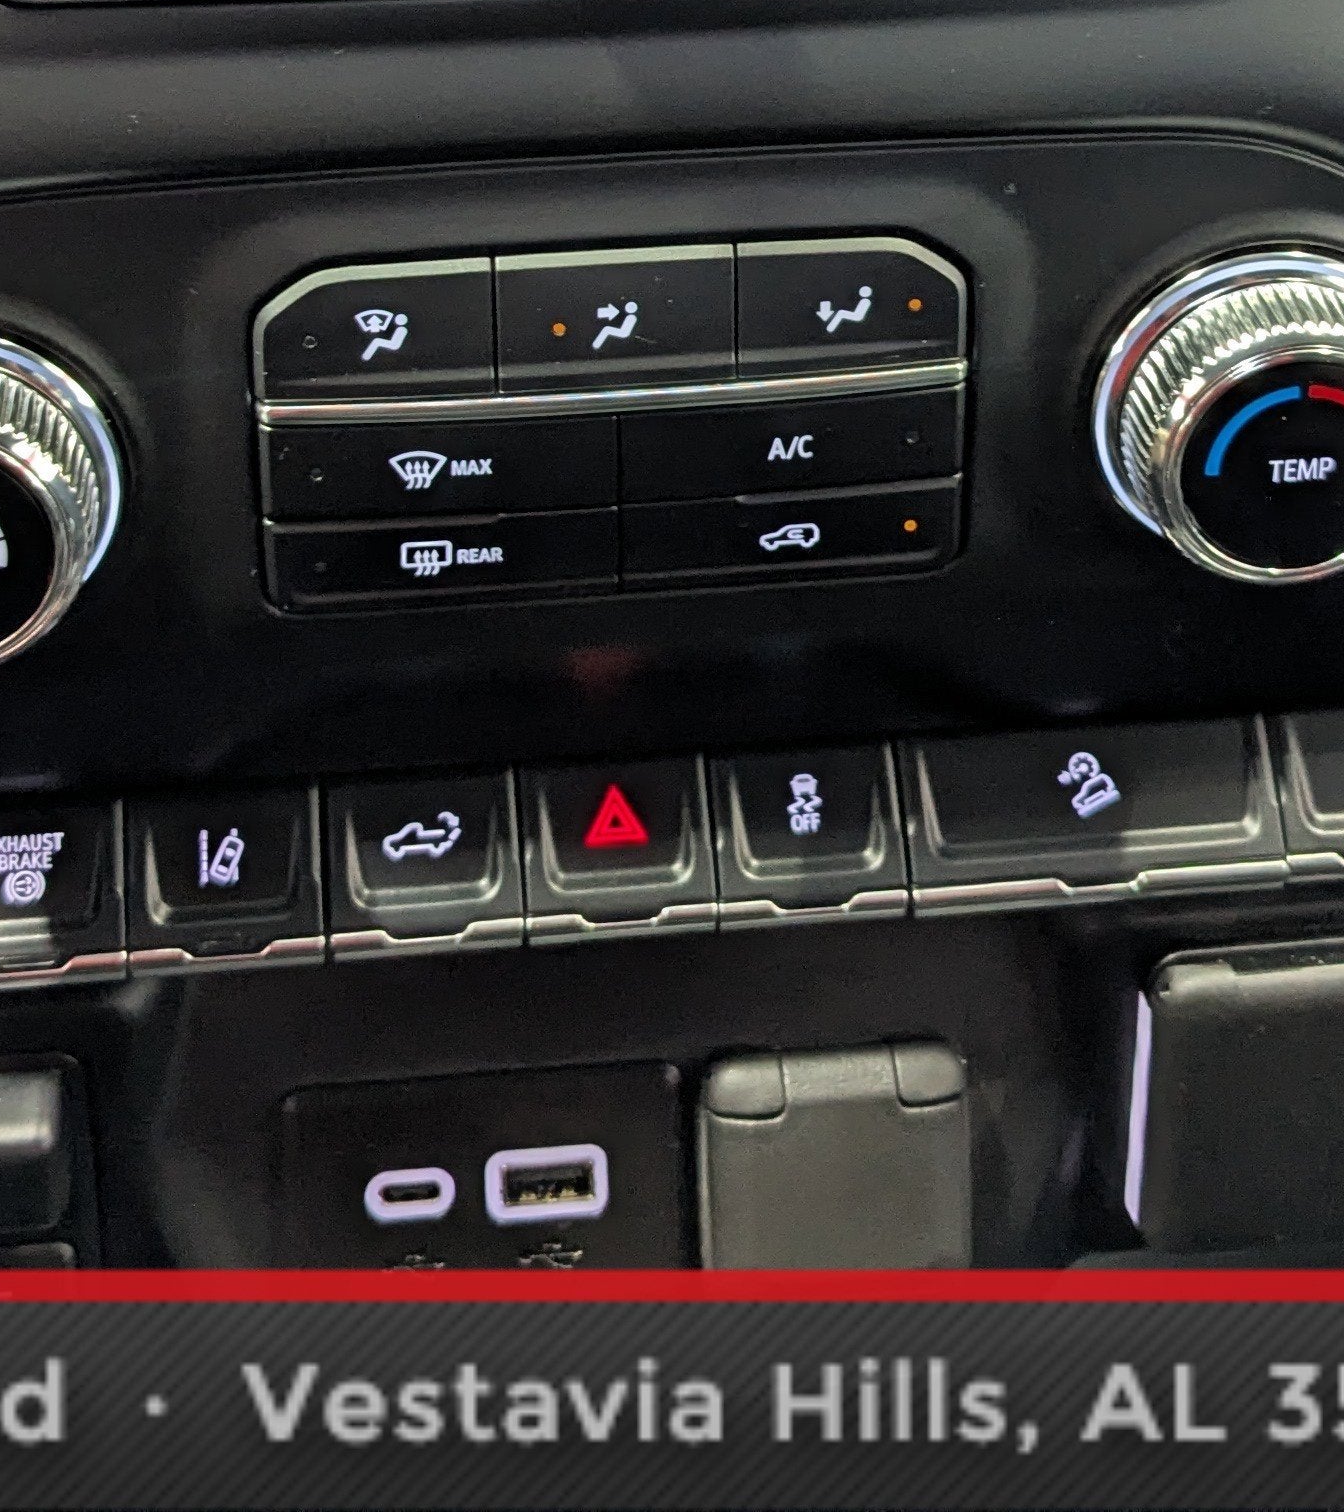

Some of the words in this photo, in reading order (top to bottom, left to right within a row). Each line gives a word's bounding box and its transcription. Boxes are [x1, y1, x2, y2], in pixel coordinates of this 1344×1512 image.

[766, 433, 815, 463] A/C
[449, 457, 494, 478] MAX
[1267, 455, 1340, 485] TEMP
[455, 545, 505, 567] REAR
[790, 812, 822, 835] OFF
